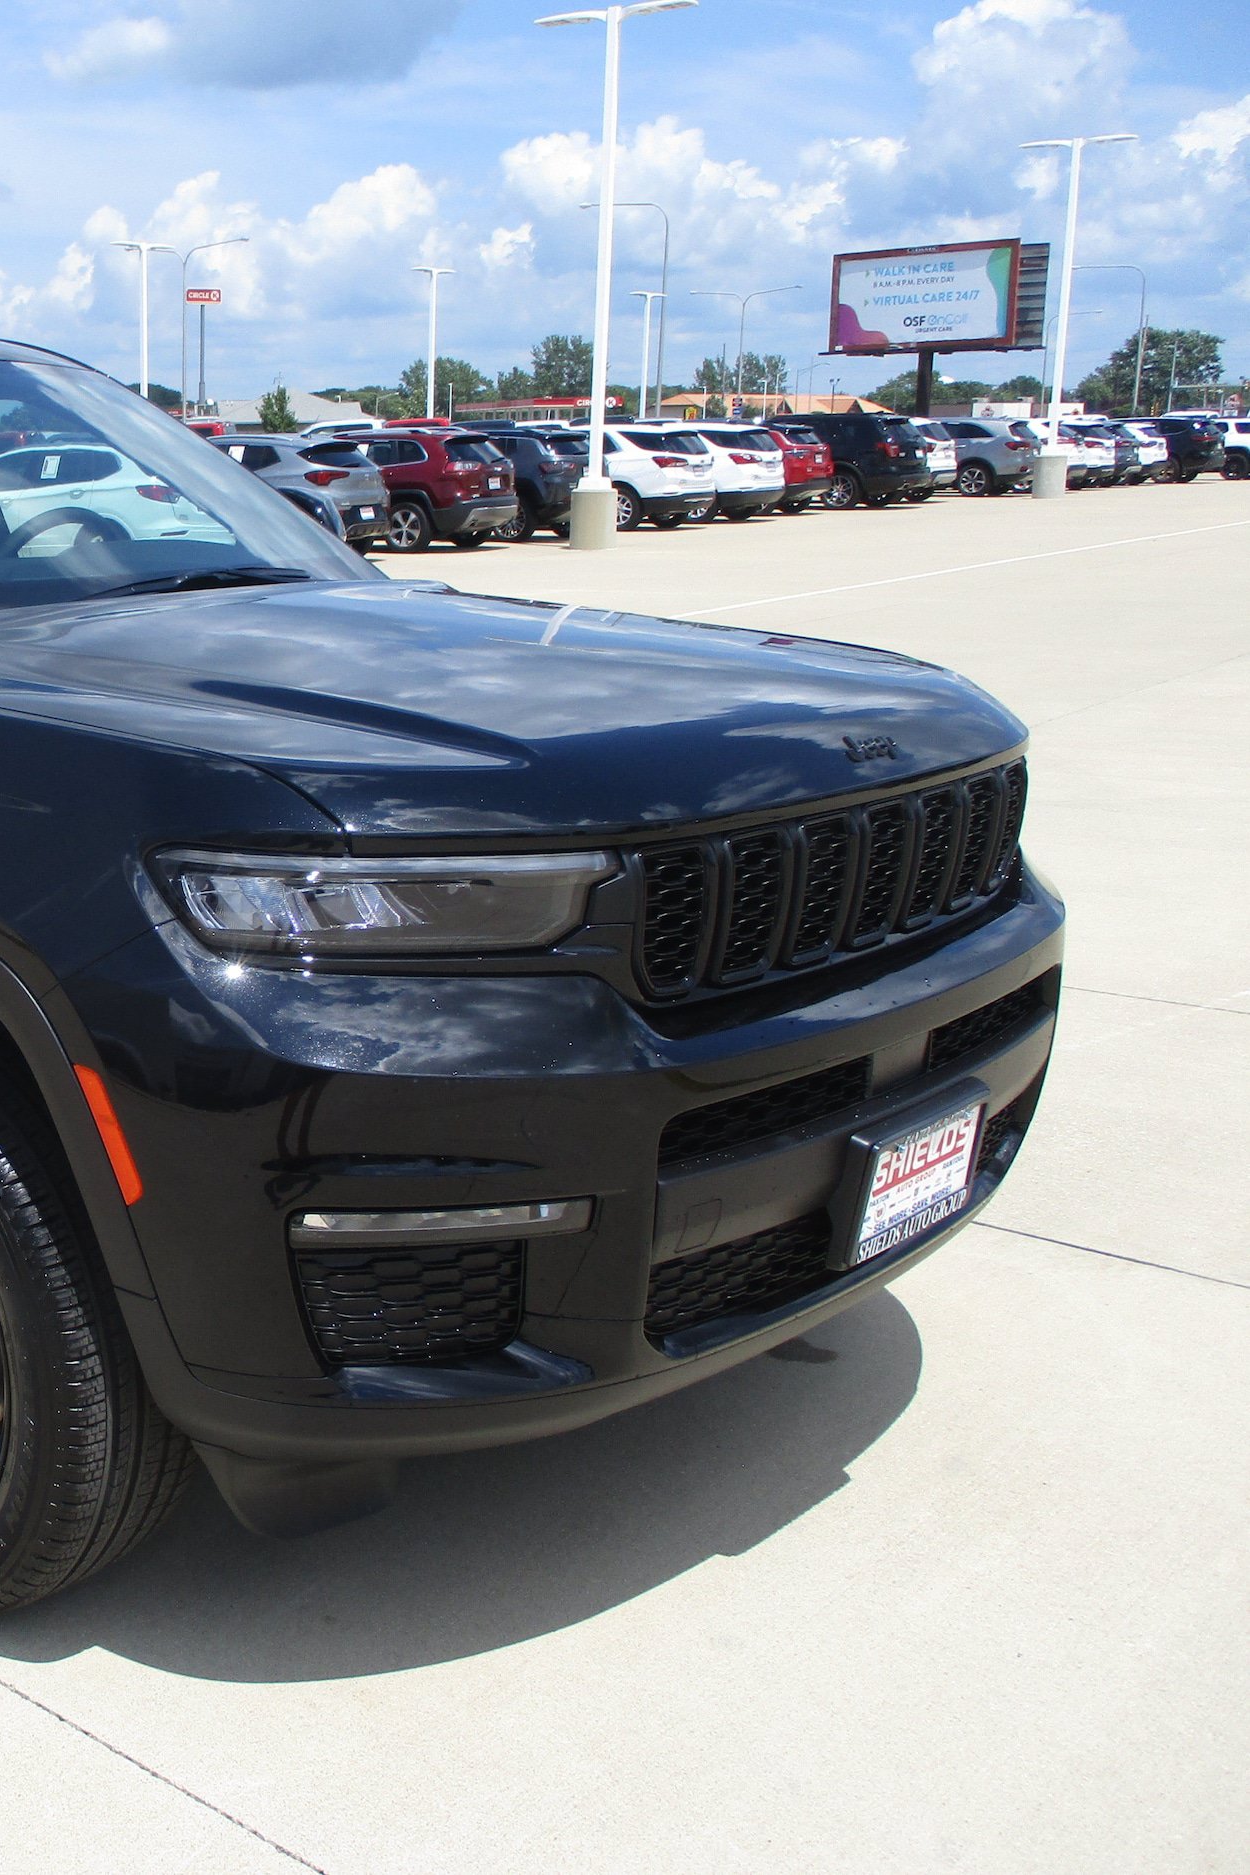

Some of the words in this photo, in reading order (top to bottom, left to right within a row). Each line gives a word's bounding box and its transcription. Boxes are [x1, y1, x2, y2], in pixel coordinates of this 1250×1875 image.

[875, 265, 906, 277] WALK
[923, 262, 955, 273] CARE
[916, 277, 939, 285] EVERY
[188, 291, 210, 299] CIRCLE
[873, 294, 919, 306] VIRTUAL
[922, 291, 954, 303] CARE
[956, 289, 980, 301] 24/7
[903, 315, 926, 327] OSF
[872, 1118, 972, 1190] SHIELDS
[897, 1179, 914, 1194] AUTO
[915, 1168, 937, 1184] GROUP
